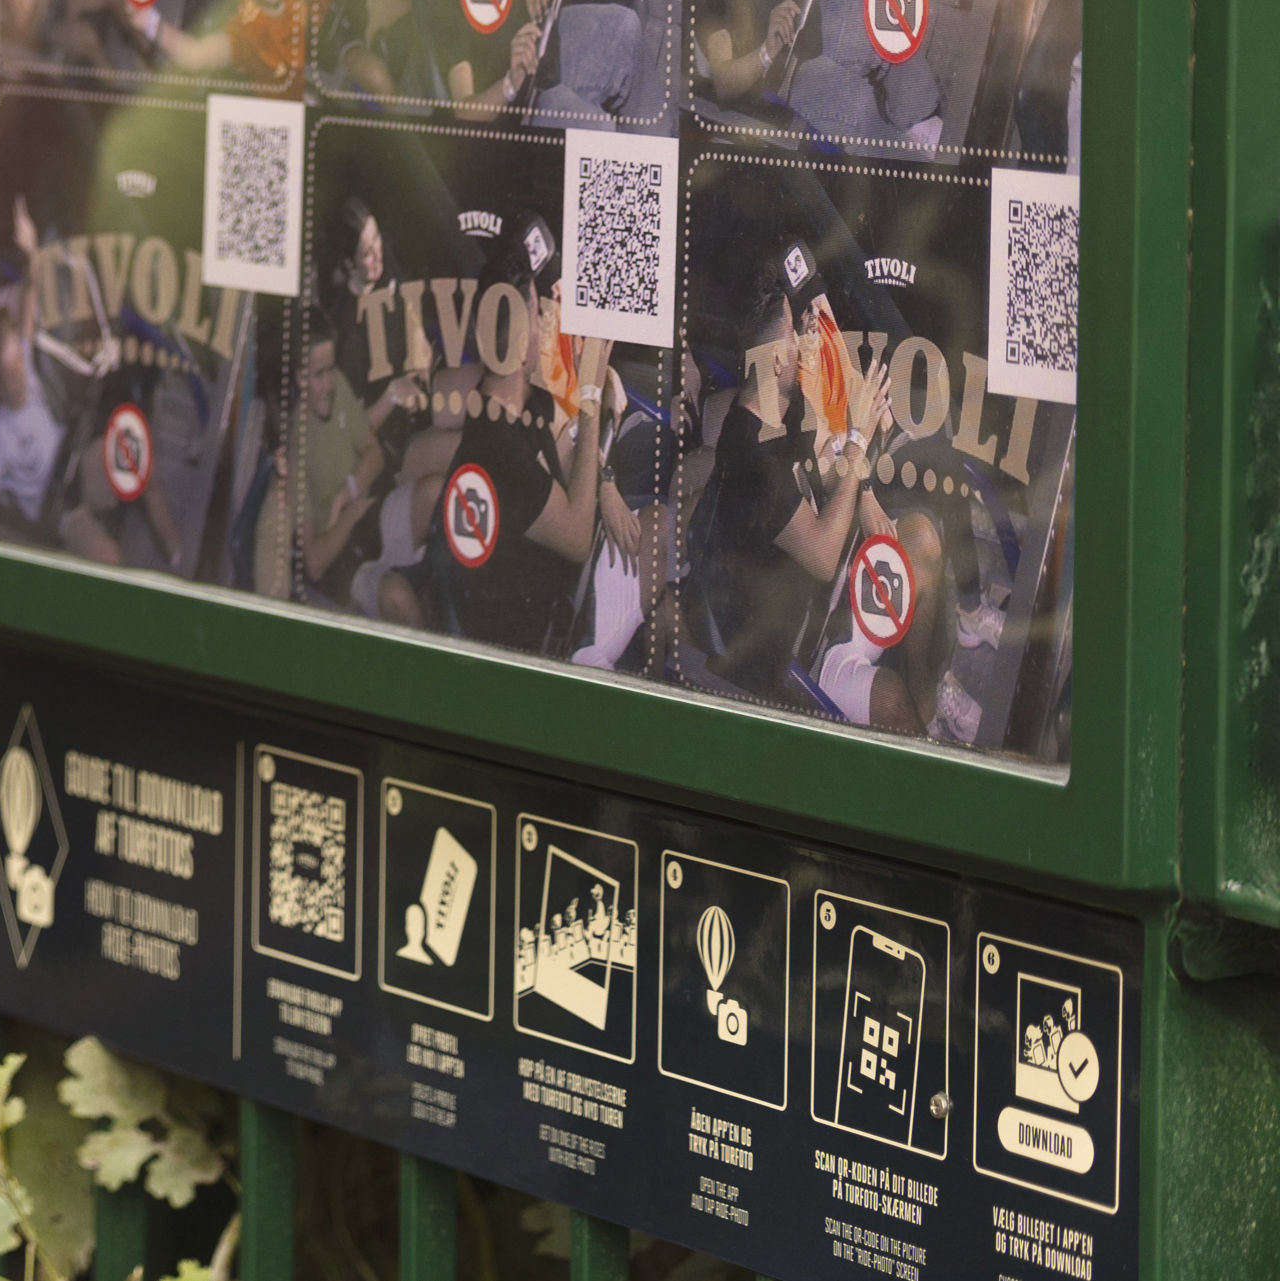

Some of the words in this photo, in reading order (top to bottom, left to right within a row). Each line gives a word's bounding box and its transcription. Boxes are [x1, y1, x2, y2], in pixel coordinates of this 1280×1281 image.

[457, 210, 503, 234] TIVOLI
[864, 257, 918, 284] TIVOLI
[136, 769, 224, 837] DOWNLOAD
[824, 908, 832, 922] 5
[987, 951, 995, 966] 6
[556, 1068, 566, 1089] AF
[690, 1106, 711, 1135] ÅBEN
[712, 1117, 740, 1144] APP'EN
[740, 1125, 752, 1148] OG
[1018, 1122, 1073, 1159] DOWNLOAD
[688, 1132, 708, 1157] TRYK
[708, 1136, 720, 1160] PÅ
[720, 1143, 754, 1172] TURFOTO
[814, 1149, 836, 1174] SCAN
[837, 1156, 878, 1188] QR-KODEN
[879, 1166, 890, 1192] PÅ
[892, 1173, 906, 1197] DIT
[907, 1178, 939, 1208] BILLEDE
[832, 1175, 843, 1201] PÅ
[844, 1182, 922, 1227] TURFOTO-SKÆRMEN
[824, 1216, 841, 1237] SCAN
[841, 1222, 853, 1241] THE
[853, 1225, 880, 1250] QR-CODE
[880, 1234, 890, 1253] ON
[890, 1237, 901, 1257] THE
[902, 1242, 927, 1266] PICTURE
[993, 1205, 1015, 1232] VÆLG
[1017, 1213, 1055, 1245] BILLEDET
[1062, 1227, 1093, 1258] APP'EN
[833, 1240, 842, 1258] ON
[843, 1243, 854, 1262] THE
[896, 1260, 920, 1281] SCREEN
[995, 1231, 1007, 1254] OG
[1008, 1235, 1030, 1262] TRYK
[1031, 1240, 1043, 1266] PÅ
[1045, 1247, 1092, 1281] DOWNLOAD
